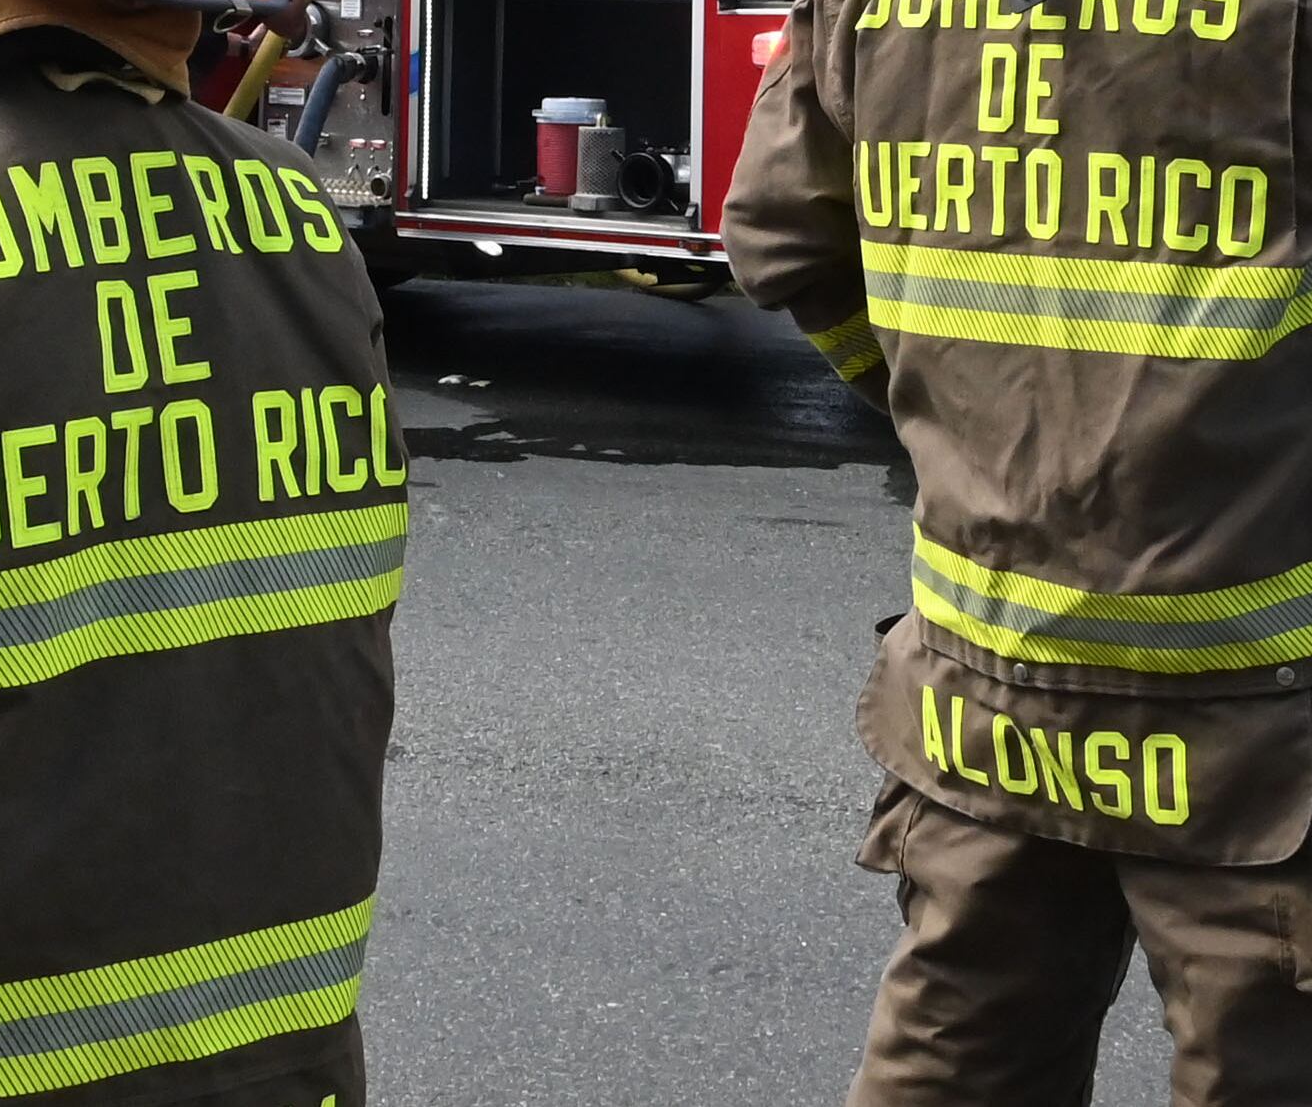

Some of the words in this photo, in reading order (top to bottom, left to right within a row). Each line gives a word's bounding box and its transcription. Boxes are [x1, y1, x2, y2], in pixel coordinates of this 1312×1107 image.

[977, 42, 1064, 135] DE
[859, 141, 1063, 241] UERTO
[1085, 151, 1268, 259] RICO
[96, 269, 212, 394] DE
[921, 684, 1190, 825] ALONSO
